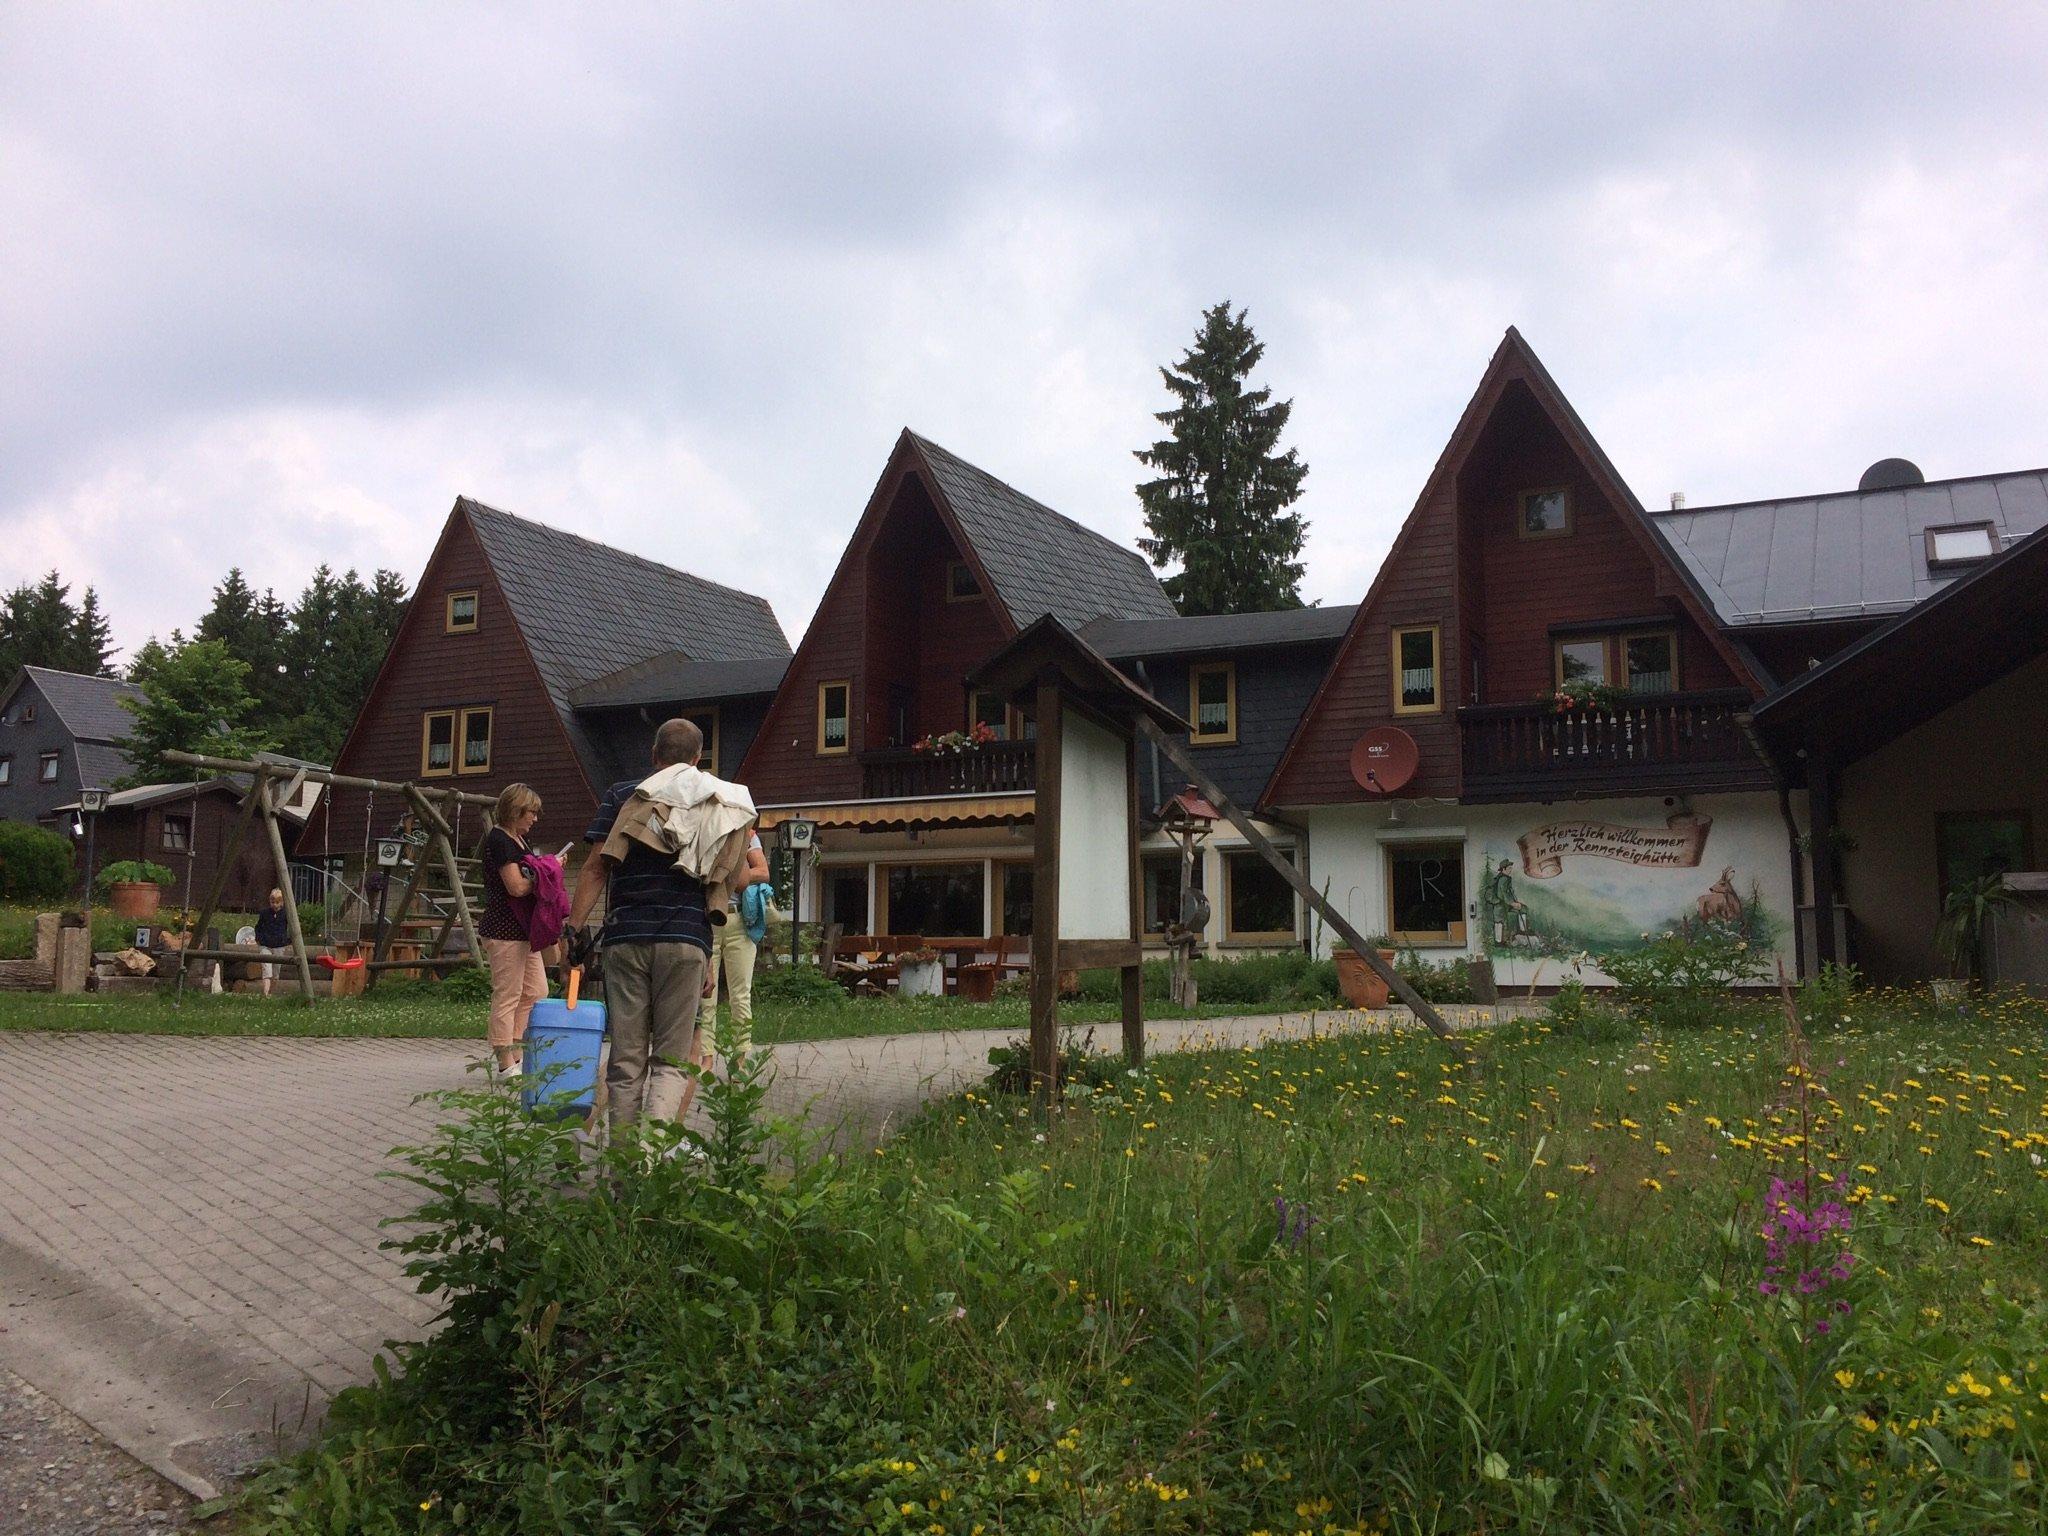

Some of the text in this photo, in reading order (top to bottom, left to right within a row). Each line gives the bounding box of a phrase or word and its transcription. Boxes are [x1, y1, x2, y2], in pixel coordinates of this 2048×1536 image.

[1540, 823, 1686, 848] Herzlich willkommen
[1536, 837, 1682, 864] in der Rennsteighütte
[1419, 858, 1445, 902] R
